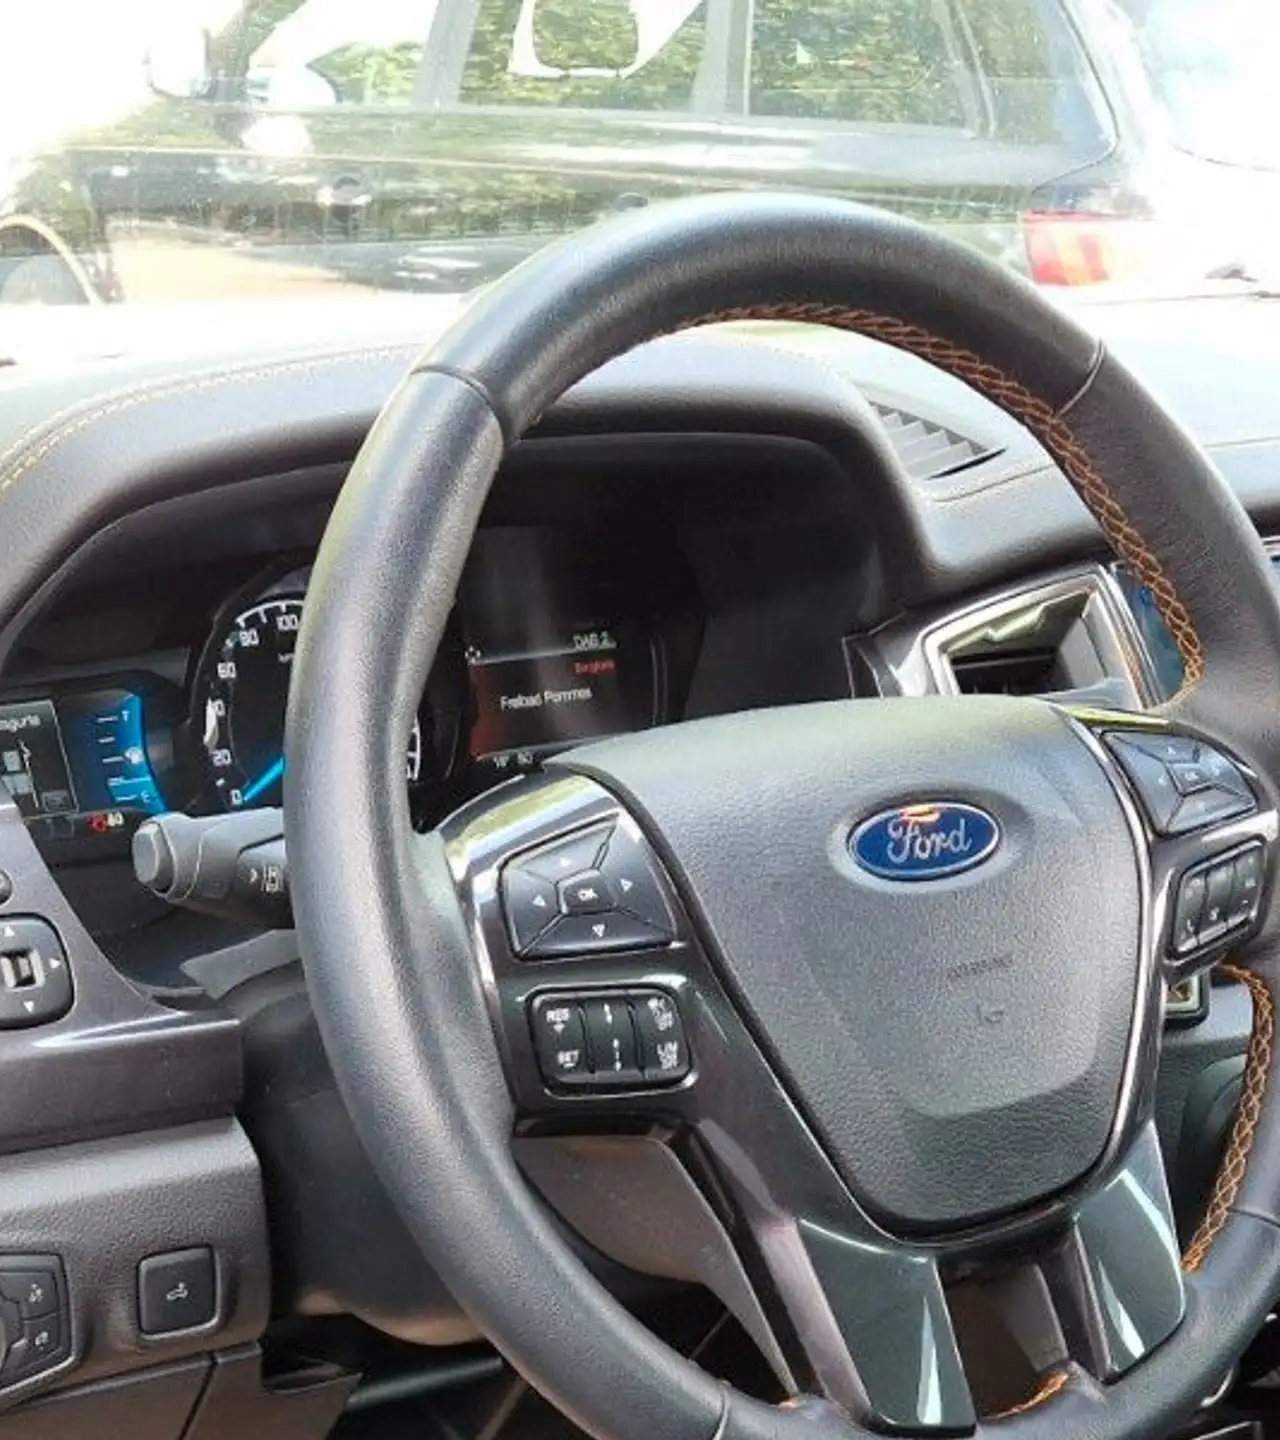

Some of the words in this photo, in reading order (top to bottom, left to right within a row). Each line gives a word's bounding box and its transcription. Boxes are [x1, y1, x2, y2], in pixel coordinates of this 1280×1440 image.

[277, 613, 300, 632] 100
[217, 661, 237, 679] 60
[211, 748, 233, 768] 20
[886, 815, 973, 864] Ford
